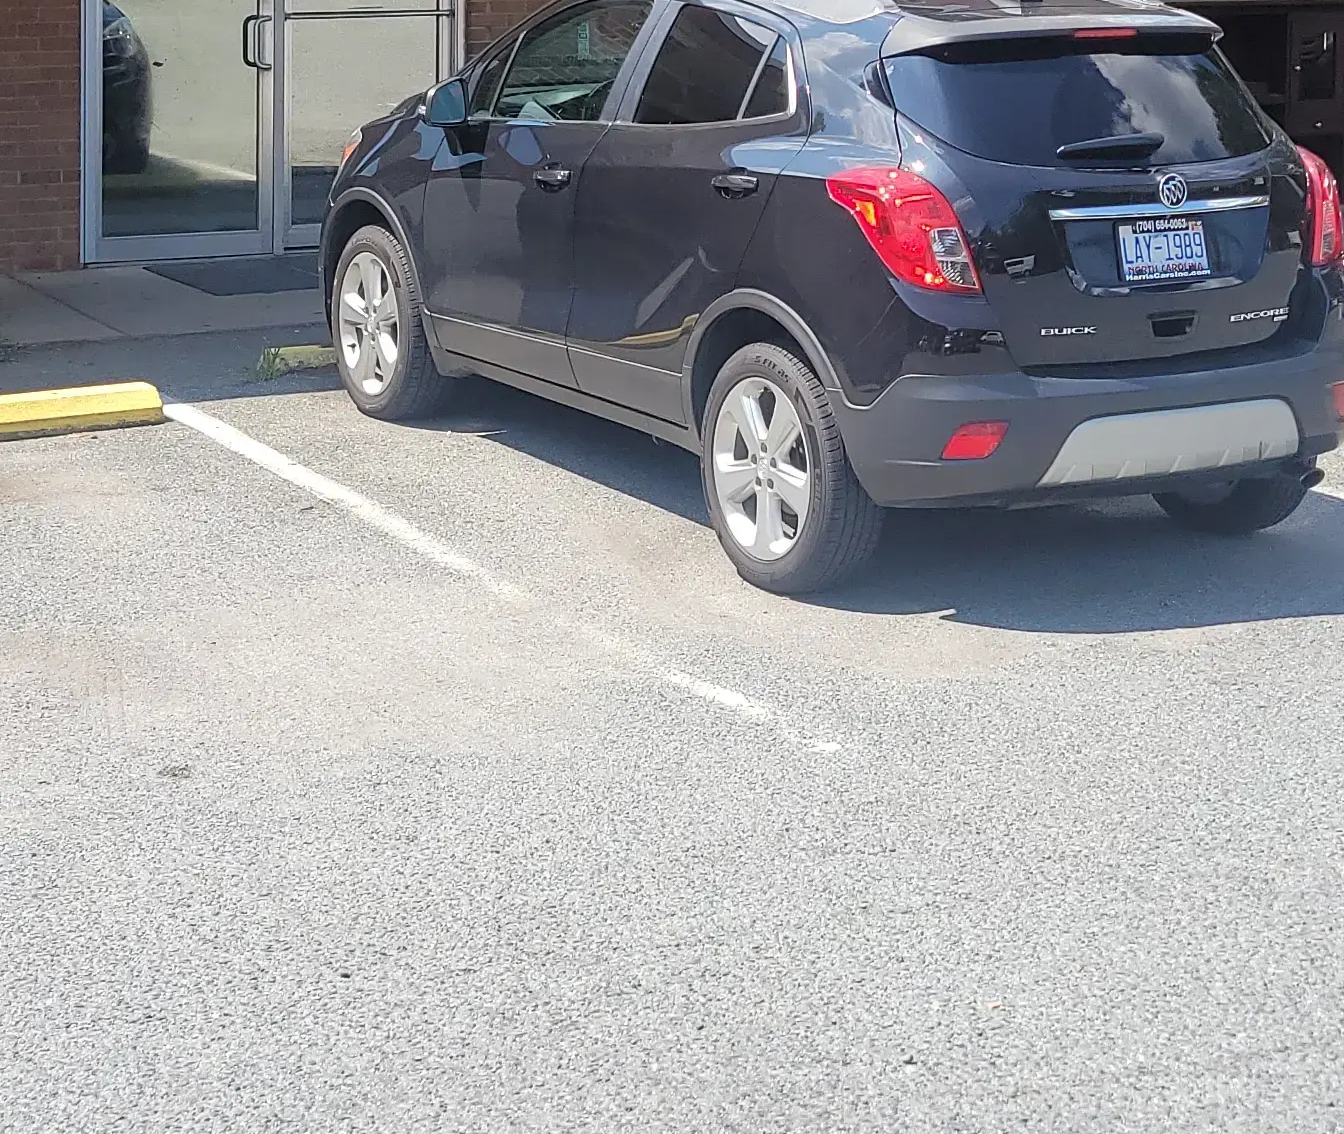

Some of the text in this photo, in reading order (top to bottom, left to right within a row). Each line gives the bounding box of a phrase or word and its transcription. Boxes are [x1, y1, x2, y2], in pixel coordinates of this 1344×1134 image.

[1136, 219, 1154, 233] (704)
[1122, 231, 1204, 264] LAY-1989
[1127, 262, 1204, 274] NORTH CAROLINA
[1230, 306, 1290, 322] ENCORE
[1040, 326, 1097, 336] BUICK
